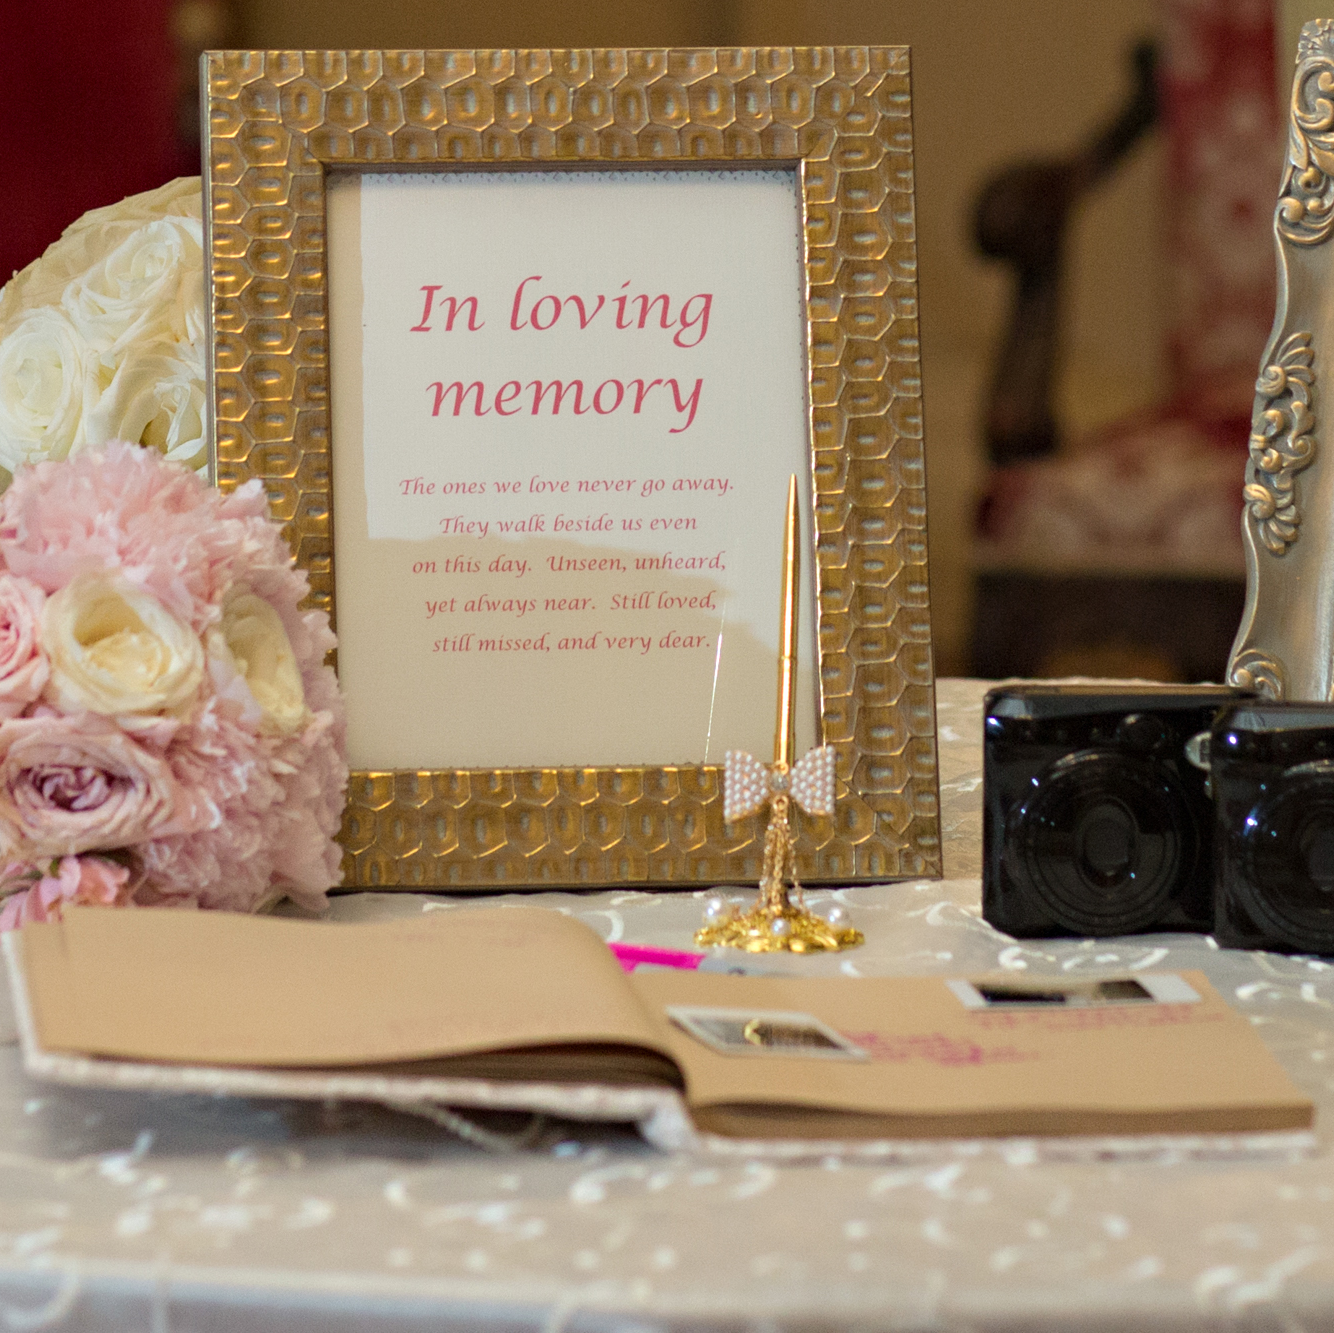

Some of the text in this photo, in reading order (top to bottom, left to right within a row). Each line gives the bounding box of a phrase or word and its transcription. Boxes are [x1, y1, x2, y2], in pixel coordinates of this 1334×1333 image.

[409, 275, 714, 349] In loving
[425, 377, 704, 433] memory
[398, 474, 734, 498] The ones we love never go away.
[439, 512, 698, 540] They walk beside us even
[411, 550, 727, 579] on this day. Unseen, unheard,
[424, 589, 717, 620] yet always near. Still loved,
[432, 629, 711, 656] still missed, and very dear.
